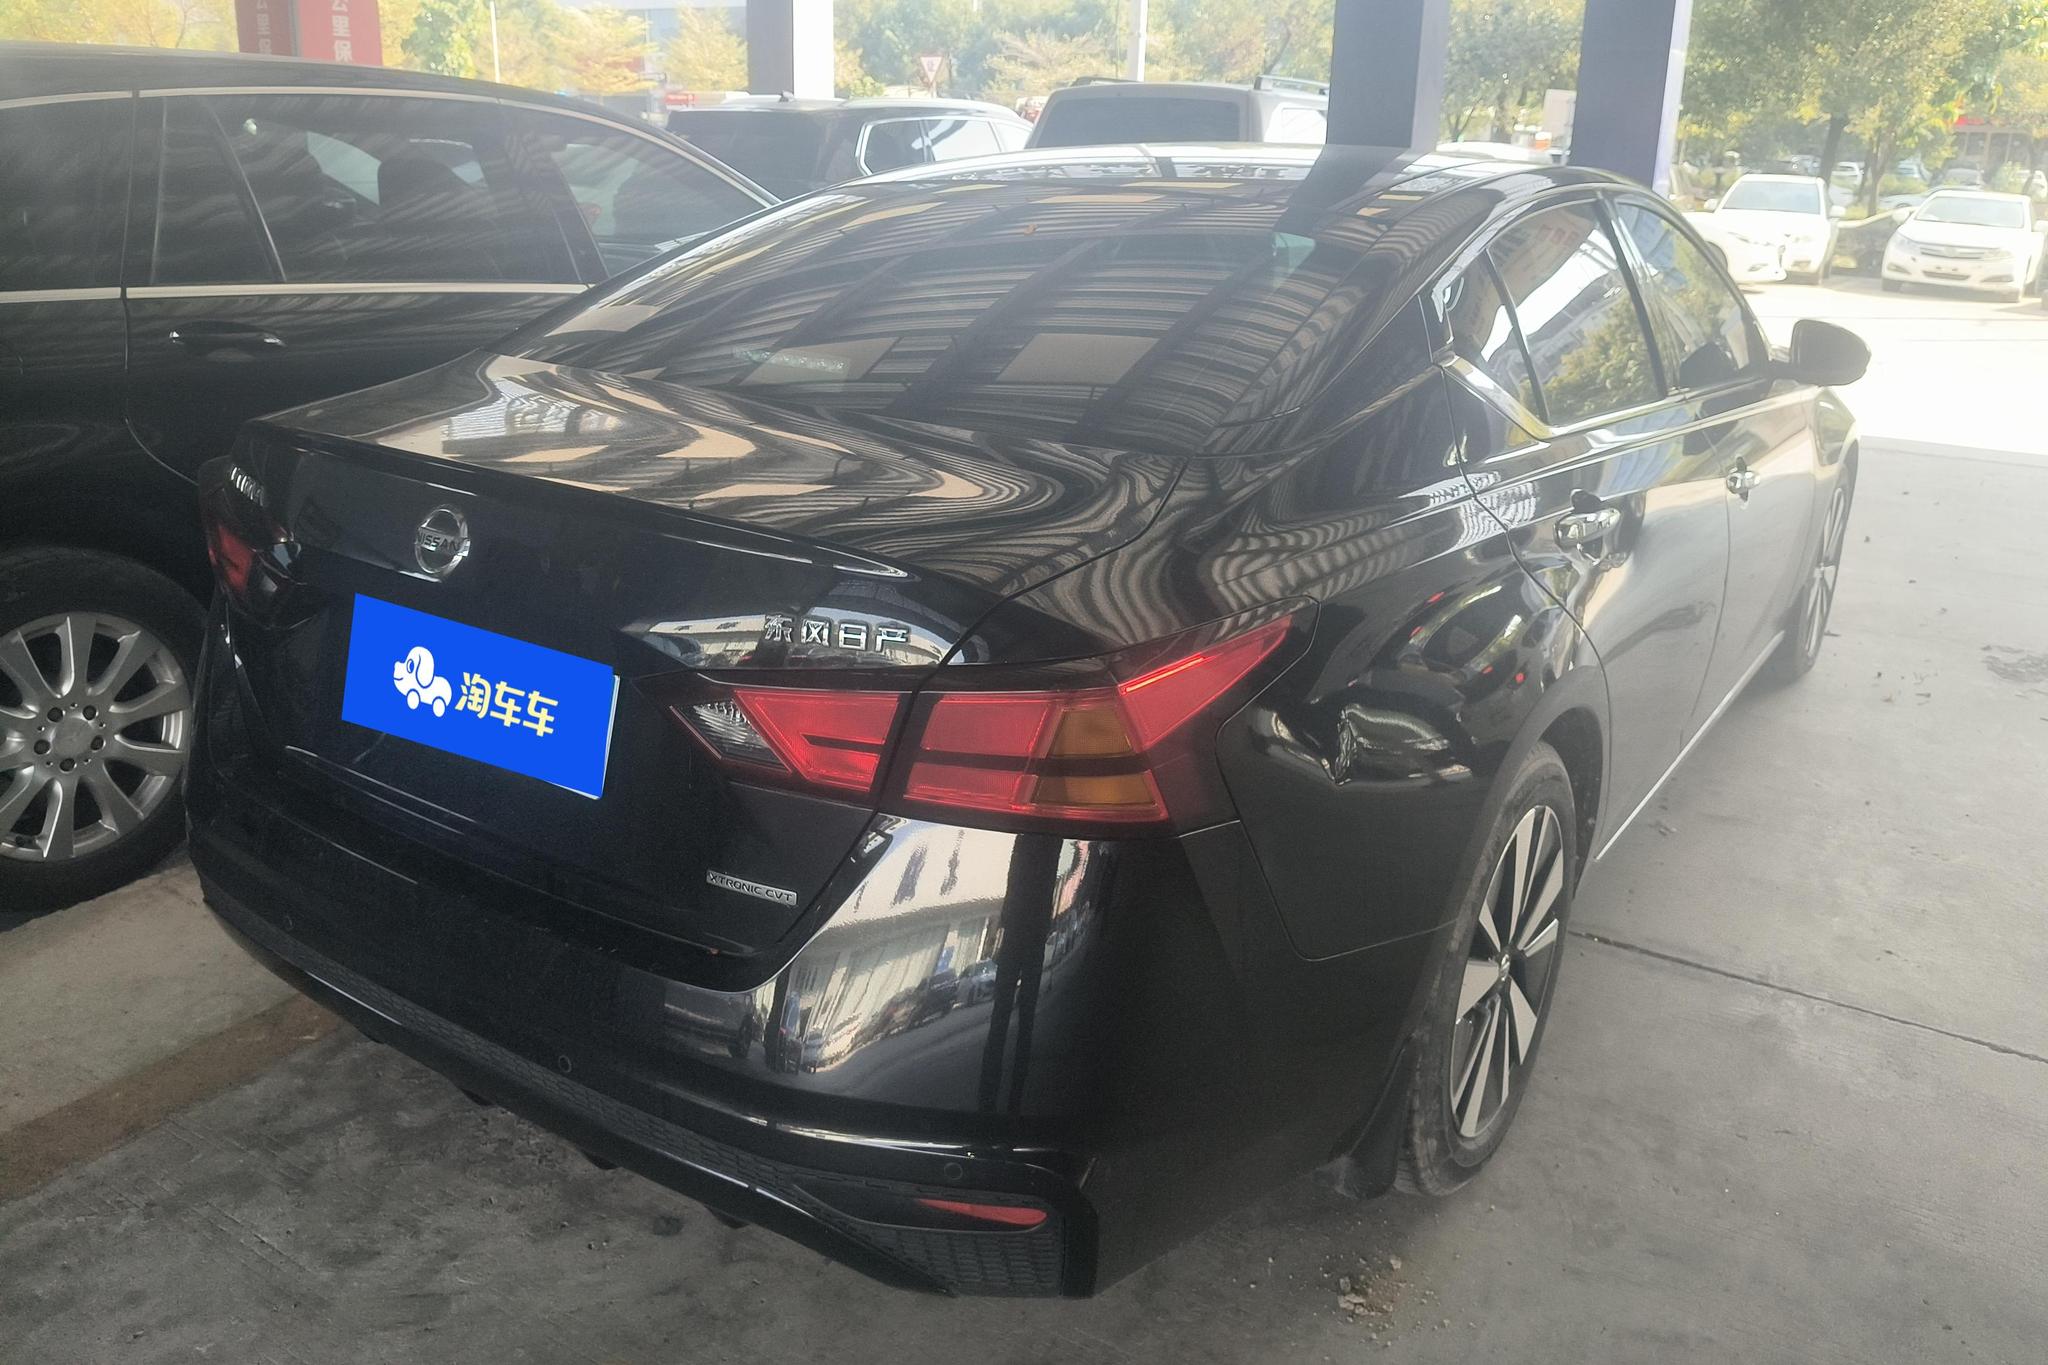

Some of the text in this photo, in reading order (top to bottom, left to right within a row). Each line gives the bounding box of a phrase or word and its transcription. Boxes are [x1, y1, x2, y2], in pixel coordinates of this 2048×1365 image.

[417, 530, 462, 552] NISSAN
[764, 614, 908, 652] 东风日产
[709, 872, 793, 902] XTRONIC CVT
